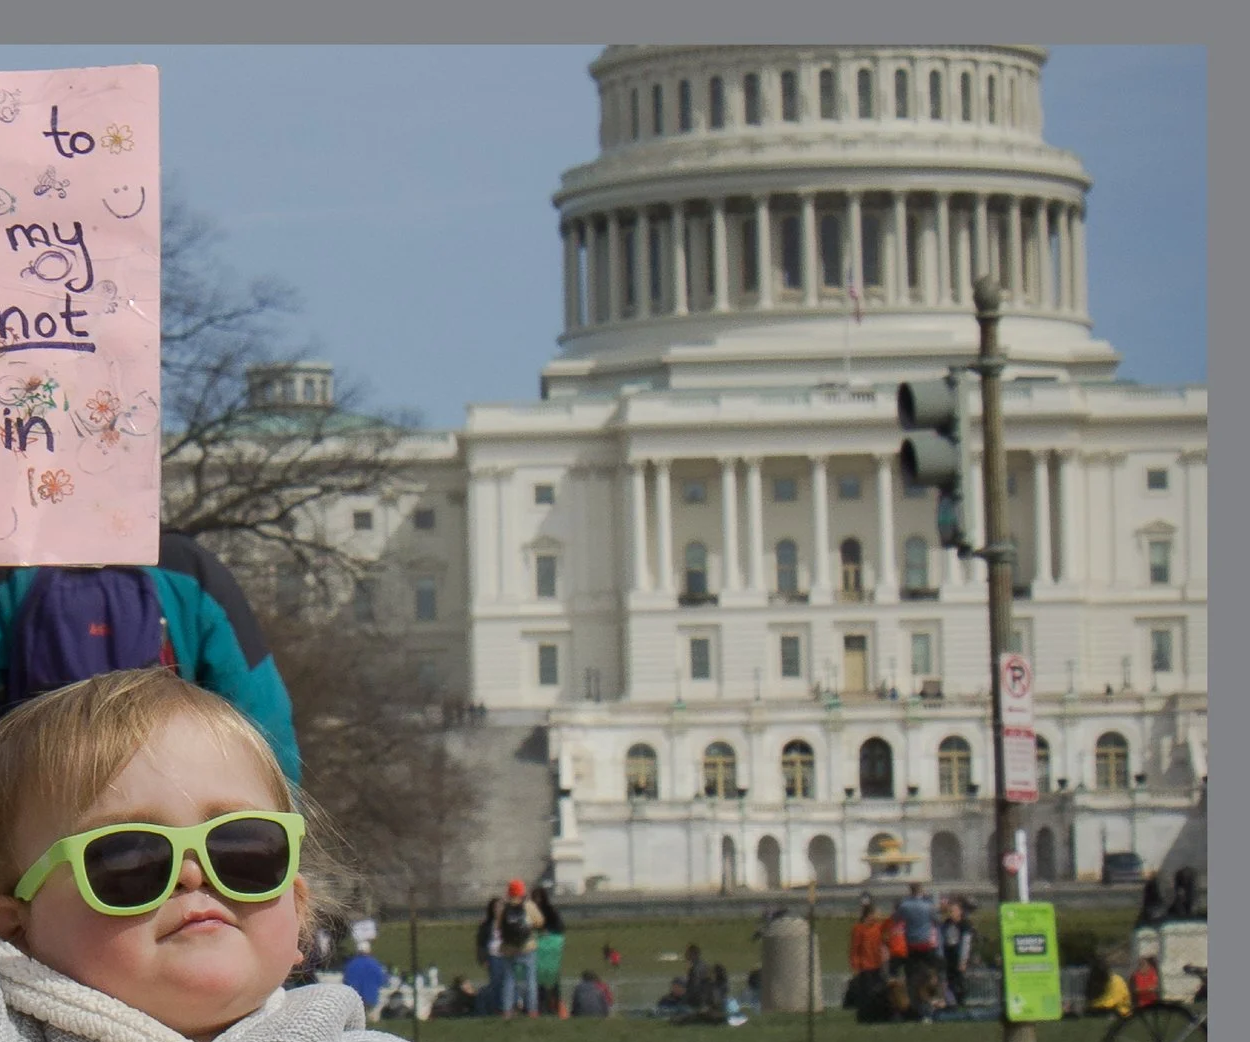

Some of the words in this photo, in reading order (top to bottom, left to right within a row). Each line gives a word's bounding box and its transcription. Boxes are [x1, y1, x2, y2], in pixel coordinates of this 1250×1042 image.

[42, 104, 96, 158] to
[4, 216, 95, 293] my
[3, 408, 56, 451] in
